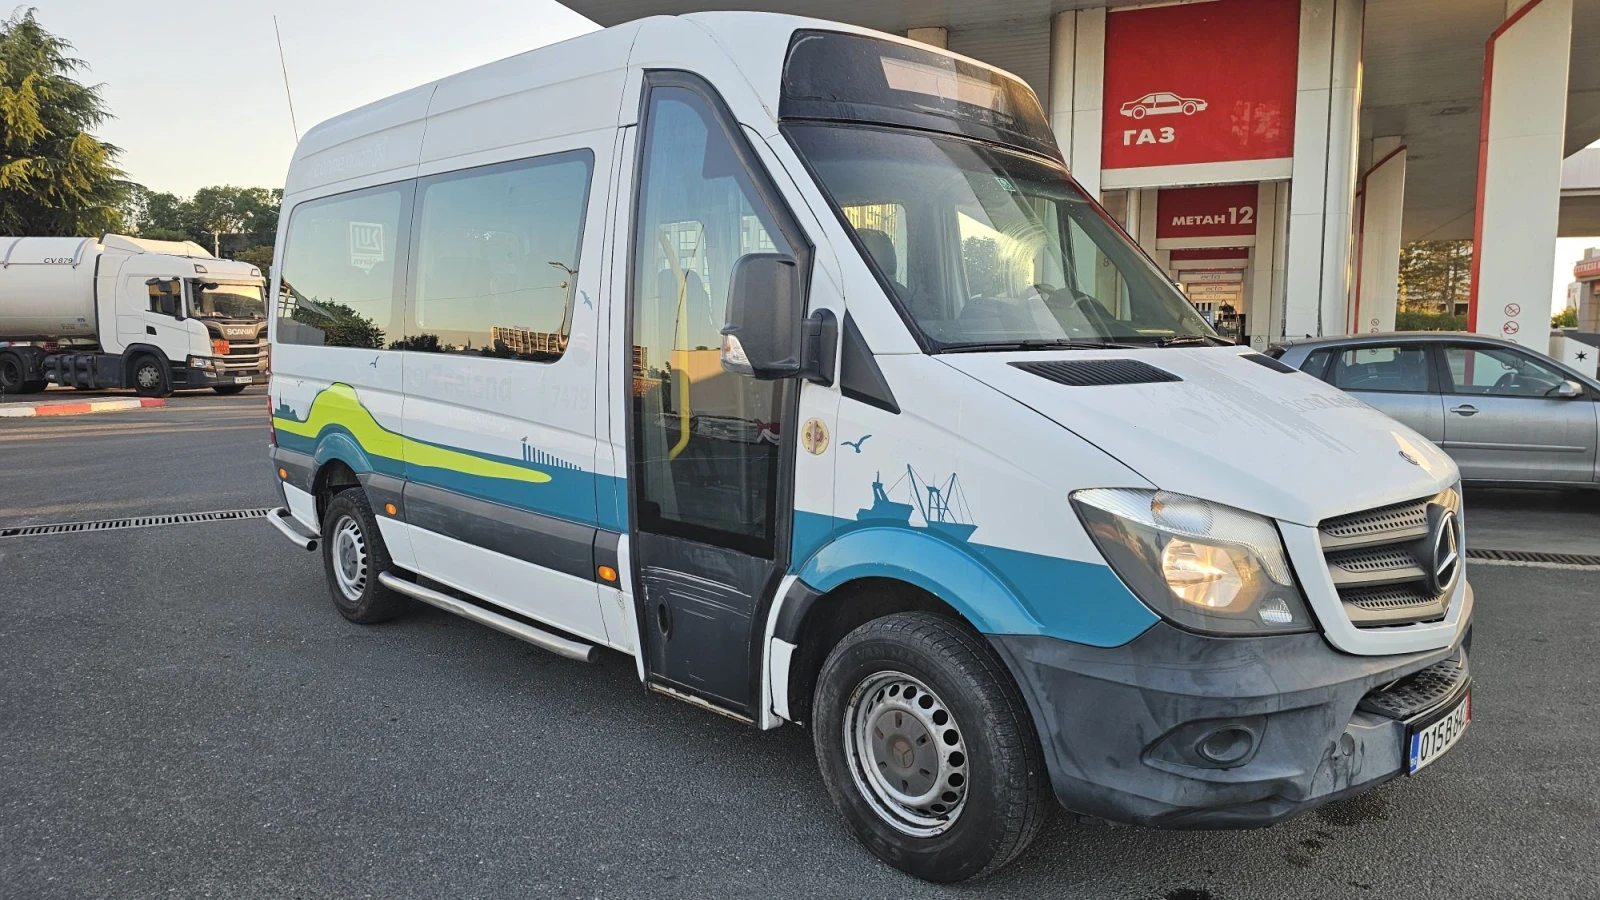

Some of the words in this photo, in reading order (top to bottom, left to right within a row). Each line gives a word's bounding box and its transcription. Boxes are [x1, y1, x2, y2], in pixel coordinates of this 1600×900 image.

[1123, 126, 1176, 146] ГАЗ
[1171, 213, 1226, 227] МЕТАН
[1228, 206, 1254, 225] 12
[1103, 257, 1110, 268] 8
